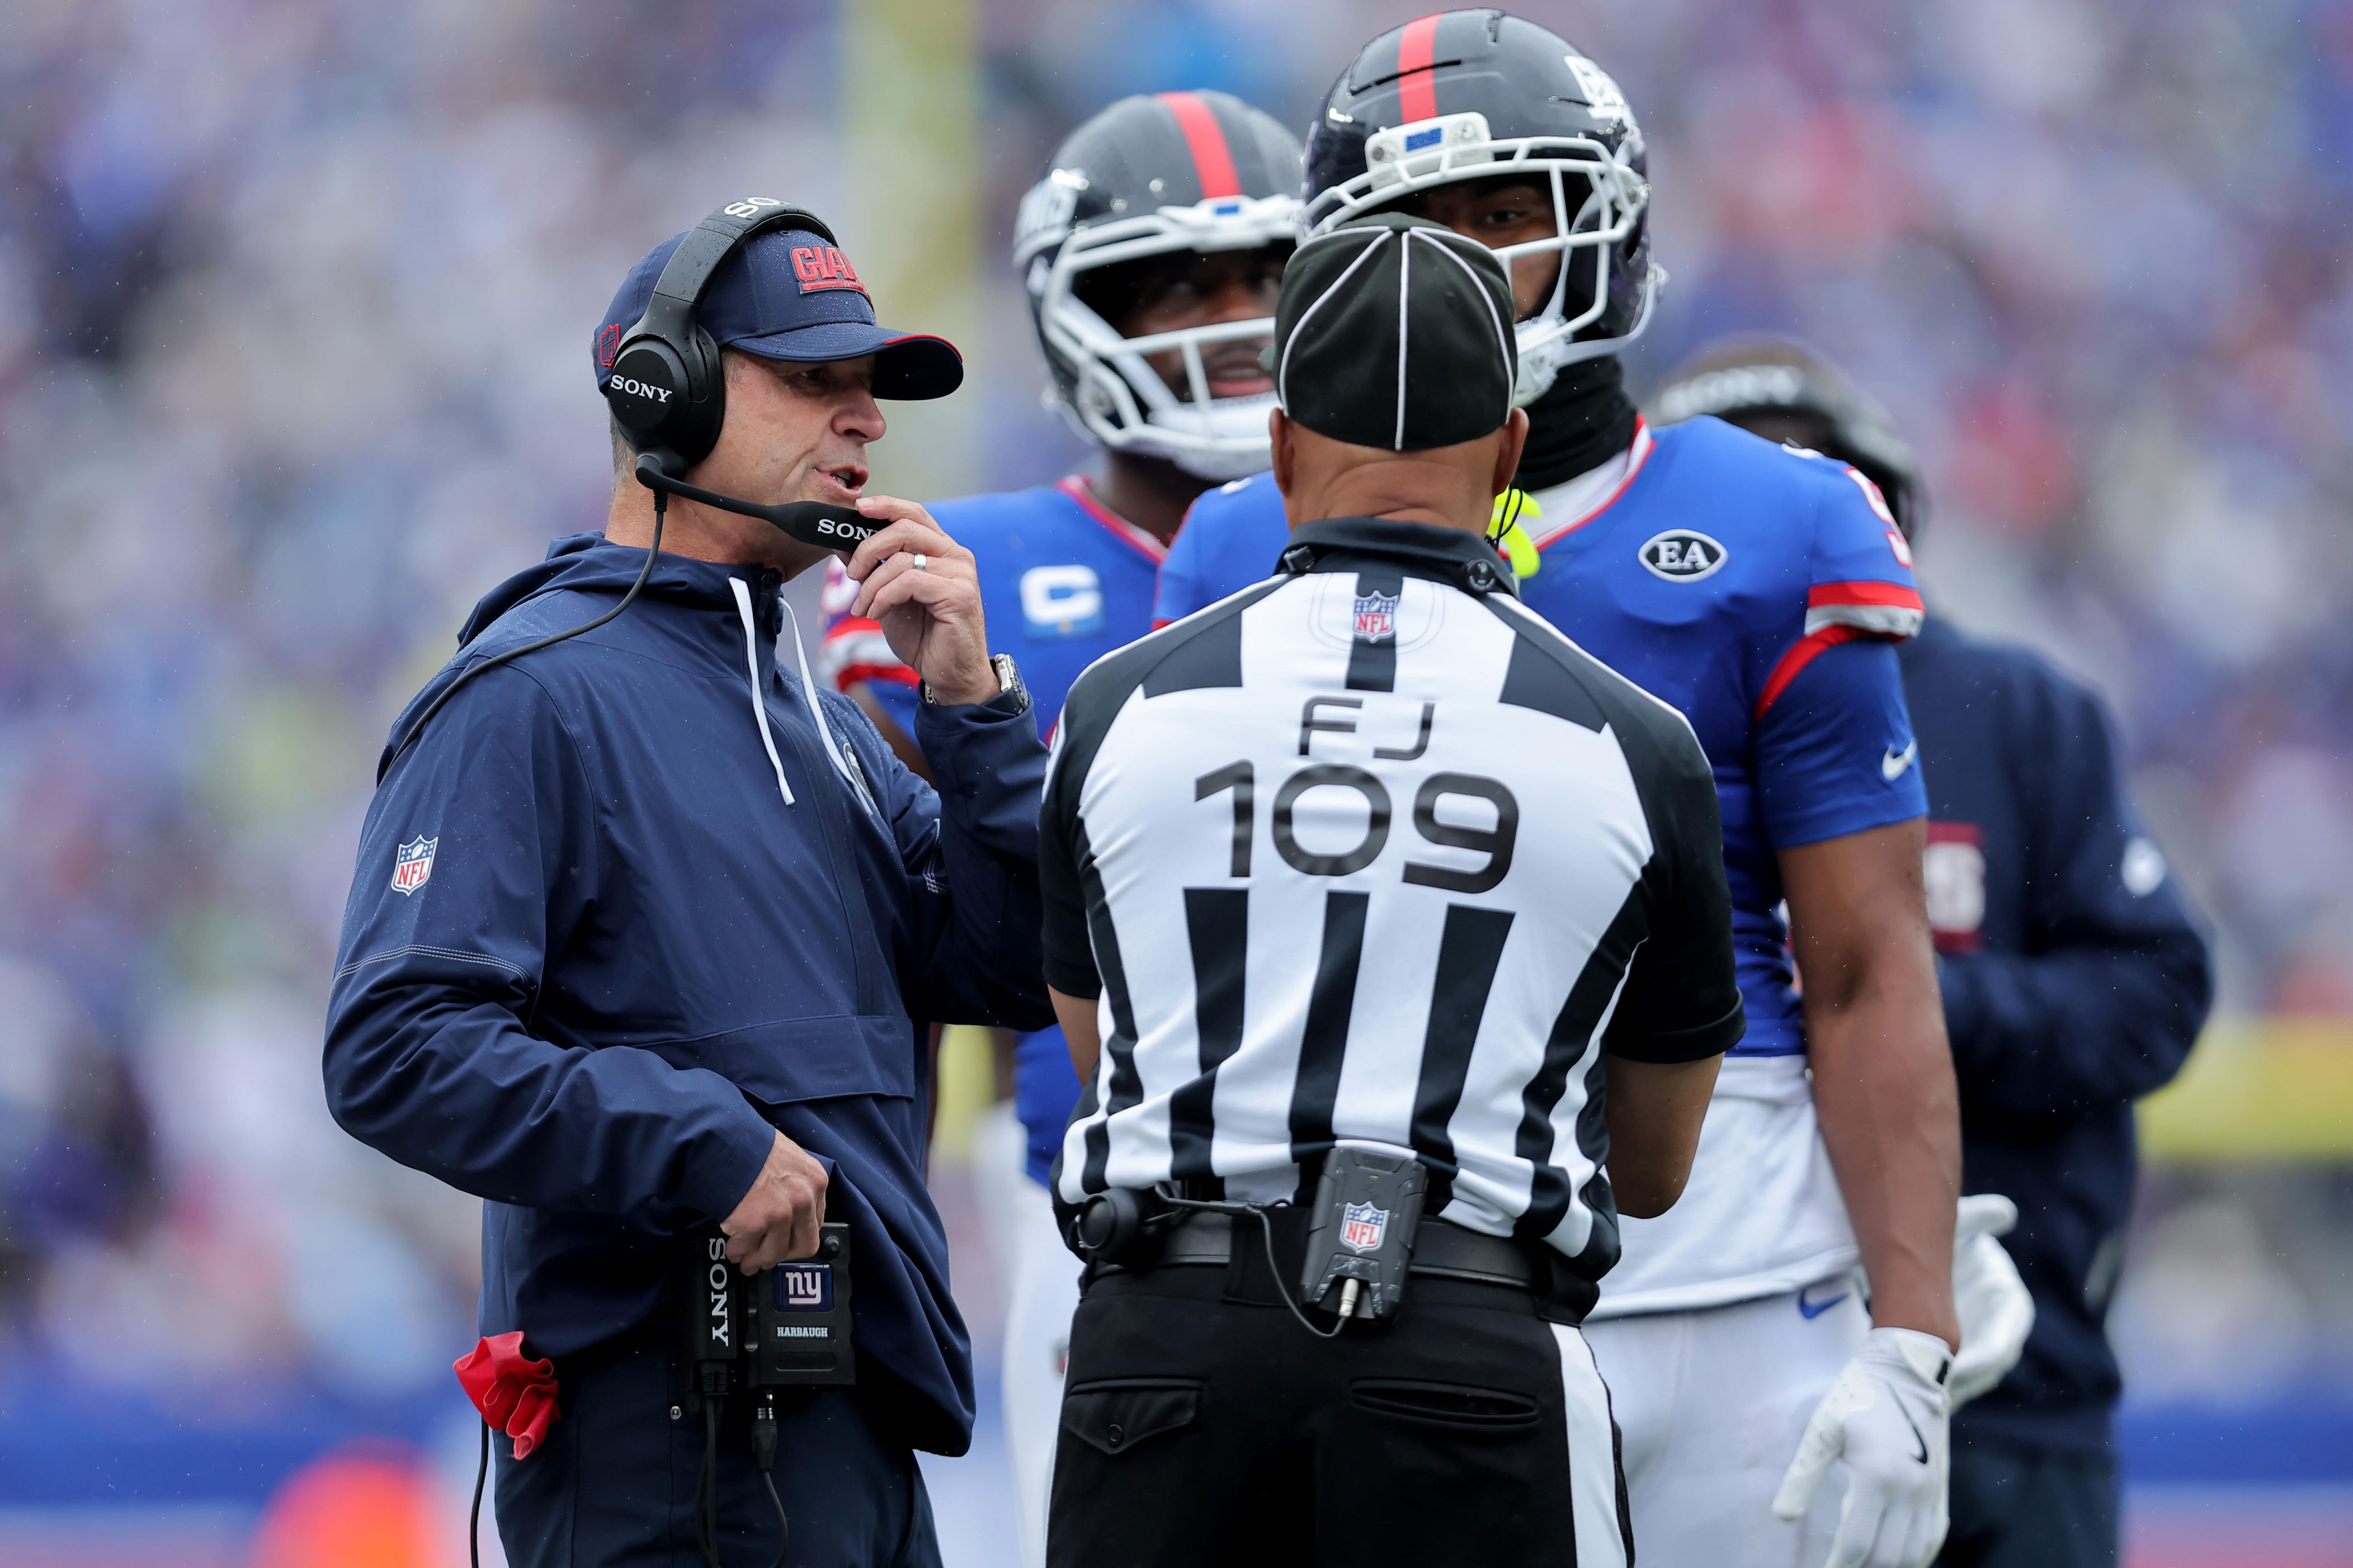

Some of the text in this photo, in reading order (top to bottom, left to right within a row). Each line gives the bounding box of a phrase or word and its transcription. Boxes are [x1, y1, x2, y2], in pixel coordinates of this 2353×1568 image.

[724, 197, 792, 218] SO
[610, 375, 672, 403] SONY
[818, 519, 879, 540] SON
[1654, 541, 1712, 570] EA
[1020, 564, 1101, 623] C
[1356, 613, 1389, 634] NFL
[1298, 696, 1435, 761] FJ
[1195, 759, 1519, 894] 109
[397, 860, 426, 887] NFL
[1345, 1221, 1377, 1245] NFL
[709, 1238, 729, 1347] SONY
[777, 1326, 828, 1338] HARBAUGH
